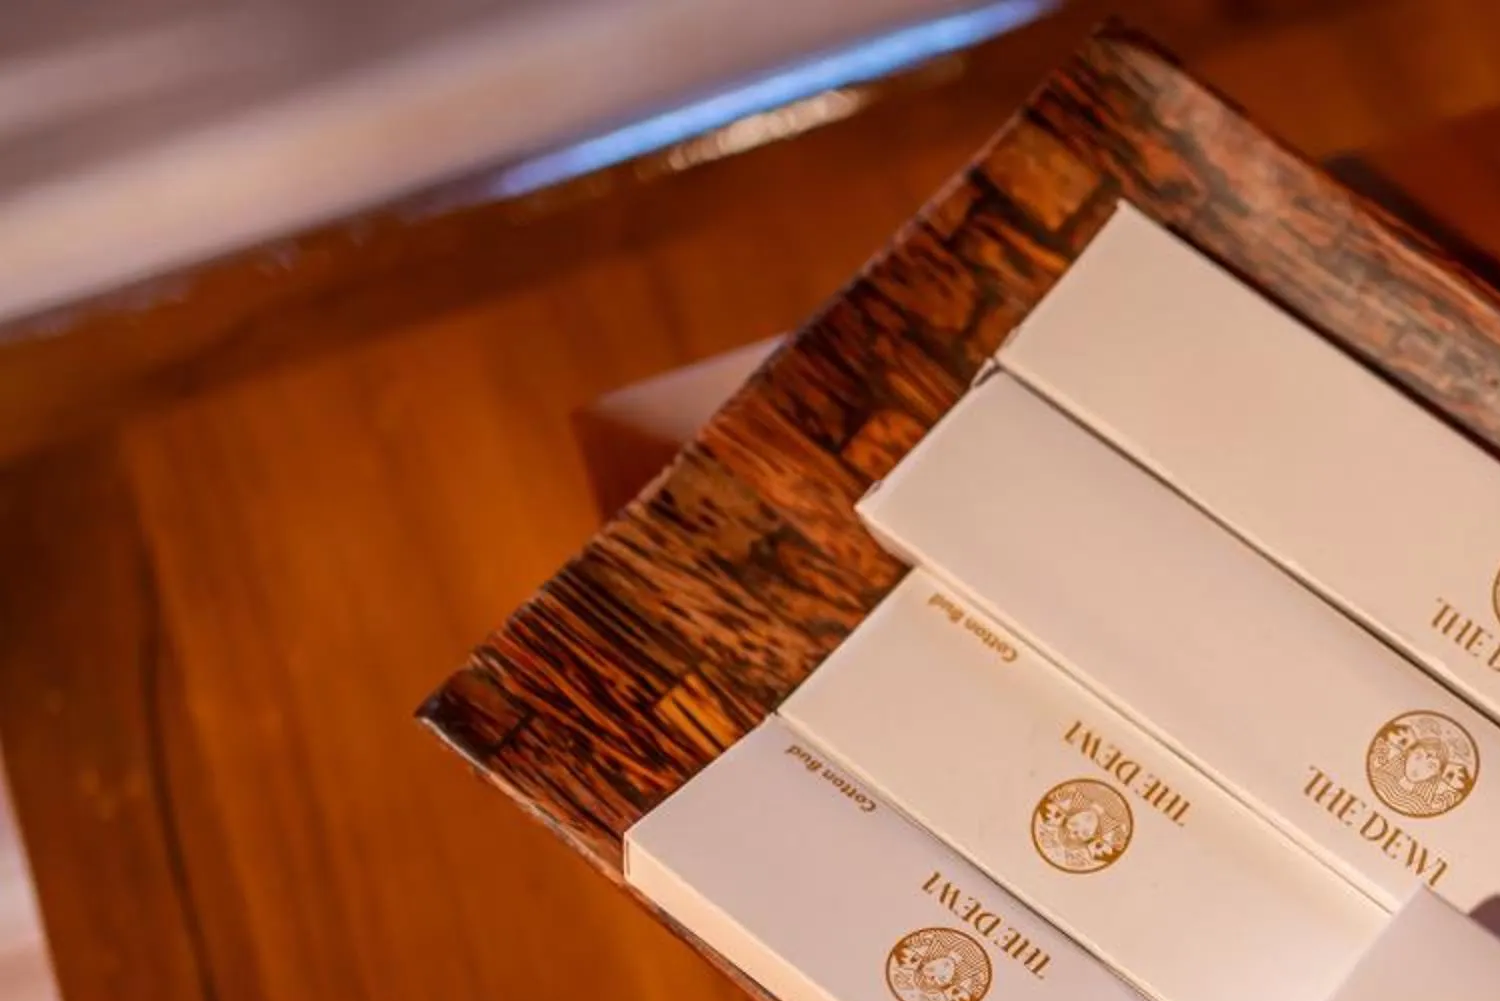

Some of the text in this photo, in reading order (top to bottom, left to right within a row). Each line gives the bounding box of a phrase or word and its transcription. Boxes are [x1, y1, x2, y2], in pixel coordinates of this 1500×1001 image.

[927, 592, 1019, 664] Cotton Bud
[1430, 597, 1494, 658] THE
[784, 743, 878, 814] Cotton Bud
[1062, 720, 1192, 828] THE DEWI
[1303, 764, 1448, 887] THE DEWI
[921, 870, 1053, 981] THE DEWI
